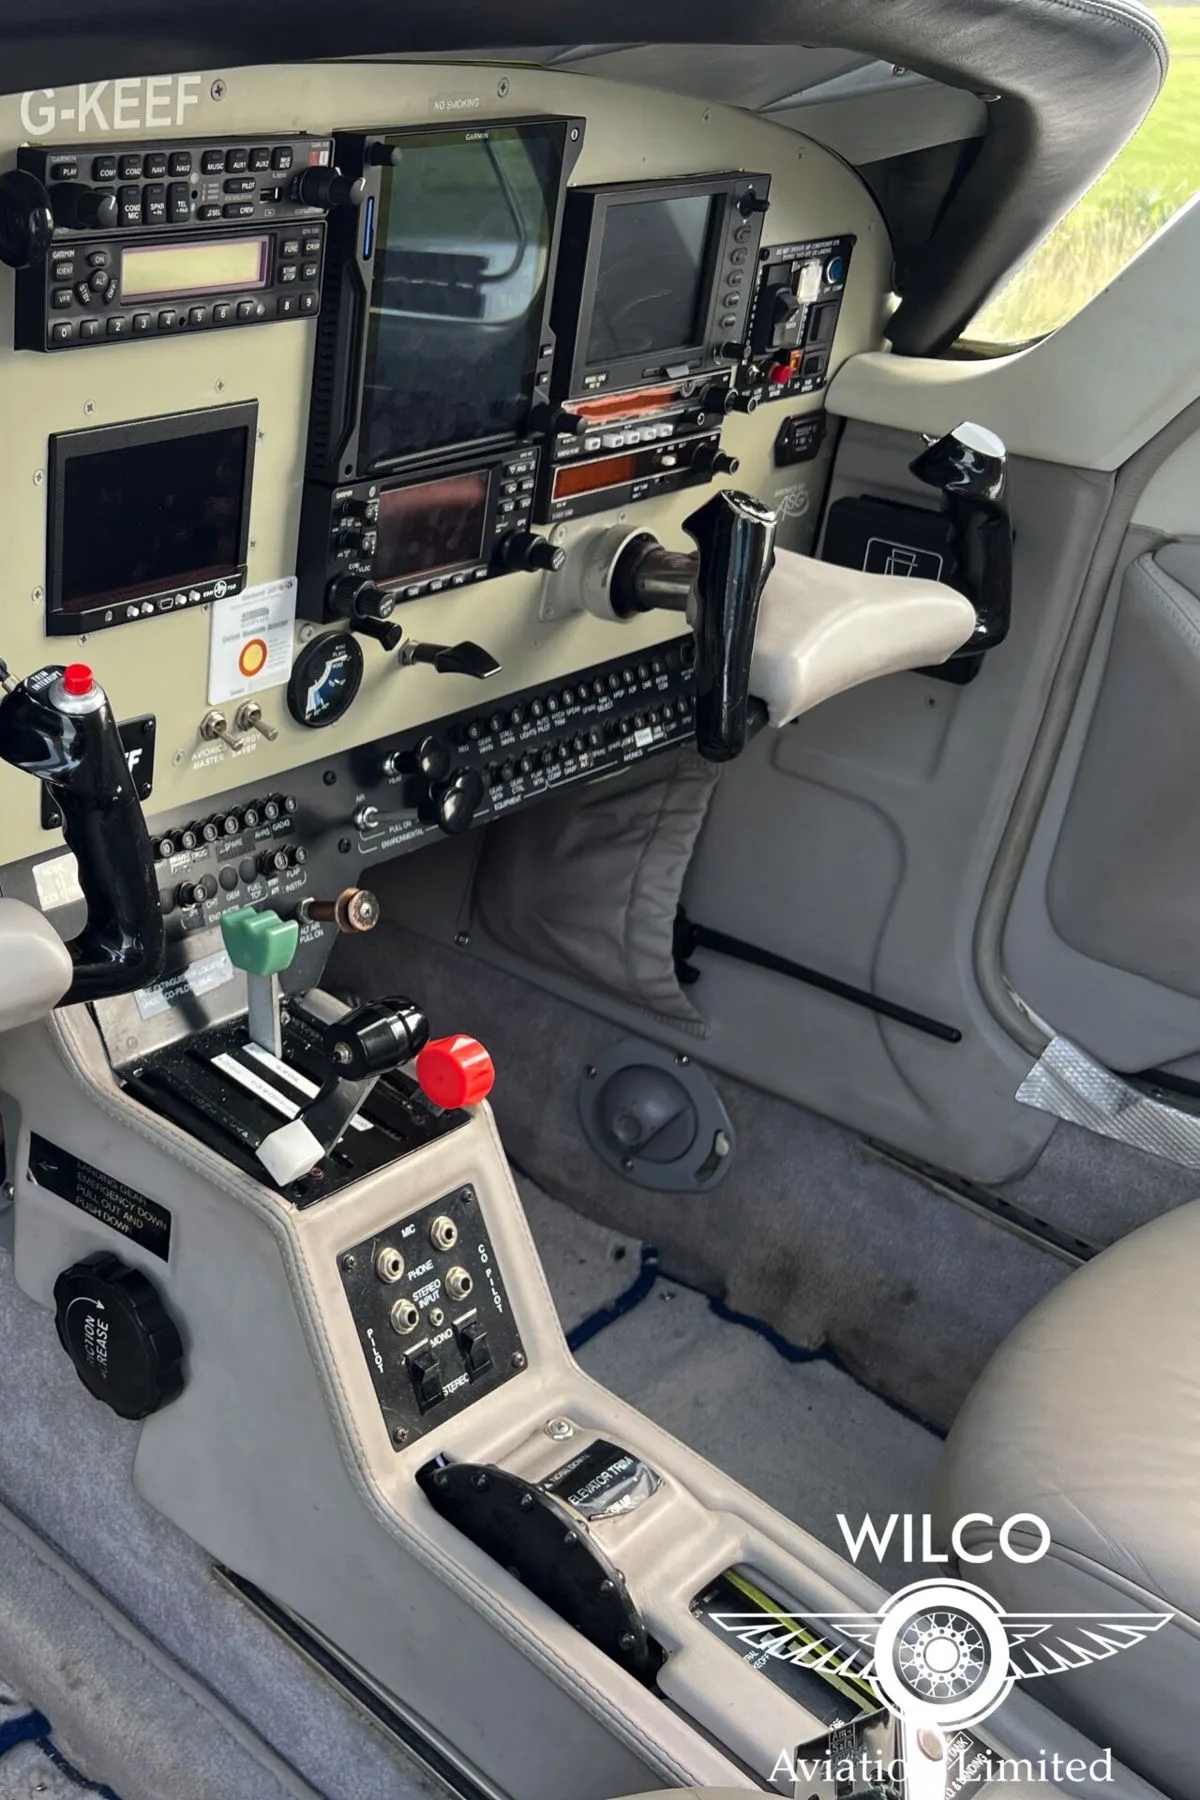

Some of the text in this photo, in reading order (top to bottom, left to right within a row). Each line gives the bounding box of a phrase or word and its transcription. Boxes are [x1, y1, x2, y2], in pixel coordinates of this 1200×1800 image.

[20, 75, 200, 136] G-KEEF
[63, 168, 77, 176] PLAY
[100, 169, 116, 177] COM1
[241, 182, 255, 190] PILOT
[240, 207, 254, 215] CREW
[31, 670, 49, 682] TRIM
[381, 828, 424, 849] ENVIRONMENTAL
[77, 1171, 167, 1231] EMERGENCY DOWN
[101, 1199, 121, 1215] OUT
[122, 1212, 144, 1229] AND
[103, 1212, 133, 1234] DOWN
[401, 1223, 416, 1238] MIC
[407, 1259, 435, 1281] PHONE
[412, 1278, 442, 1302] STEREO
[419, 1289, 441, 1310] INPUT
[485, 1268, 504, 1313] PILOT
[429, 1329, 454, 1349] MONO
[366, 1328, 385, 1374] PILOT
[567, 1468, 616, 1506] ELEVATOR
[607, 1455, 635, 1477] TRIM
